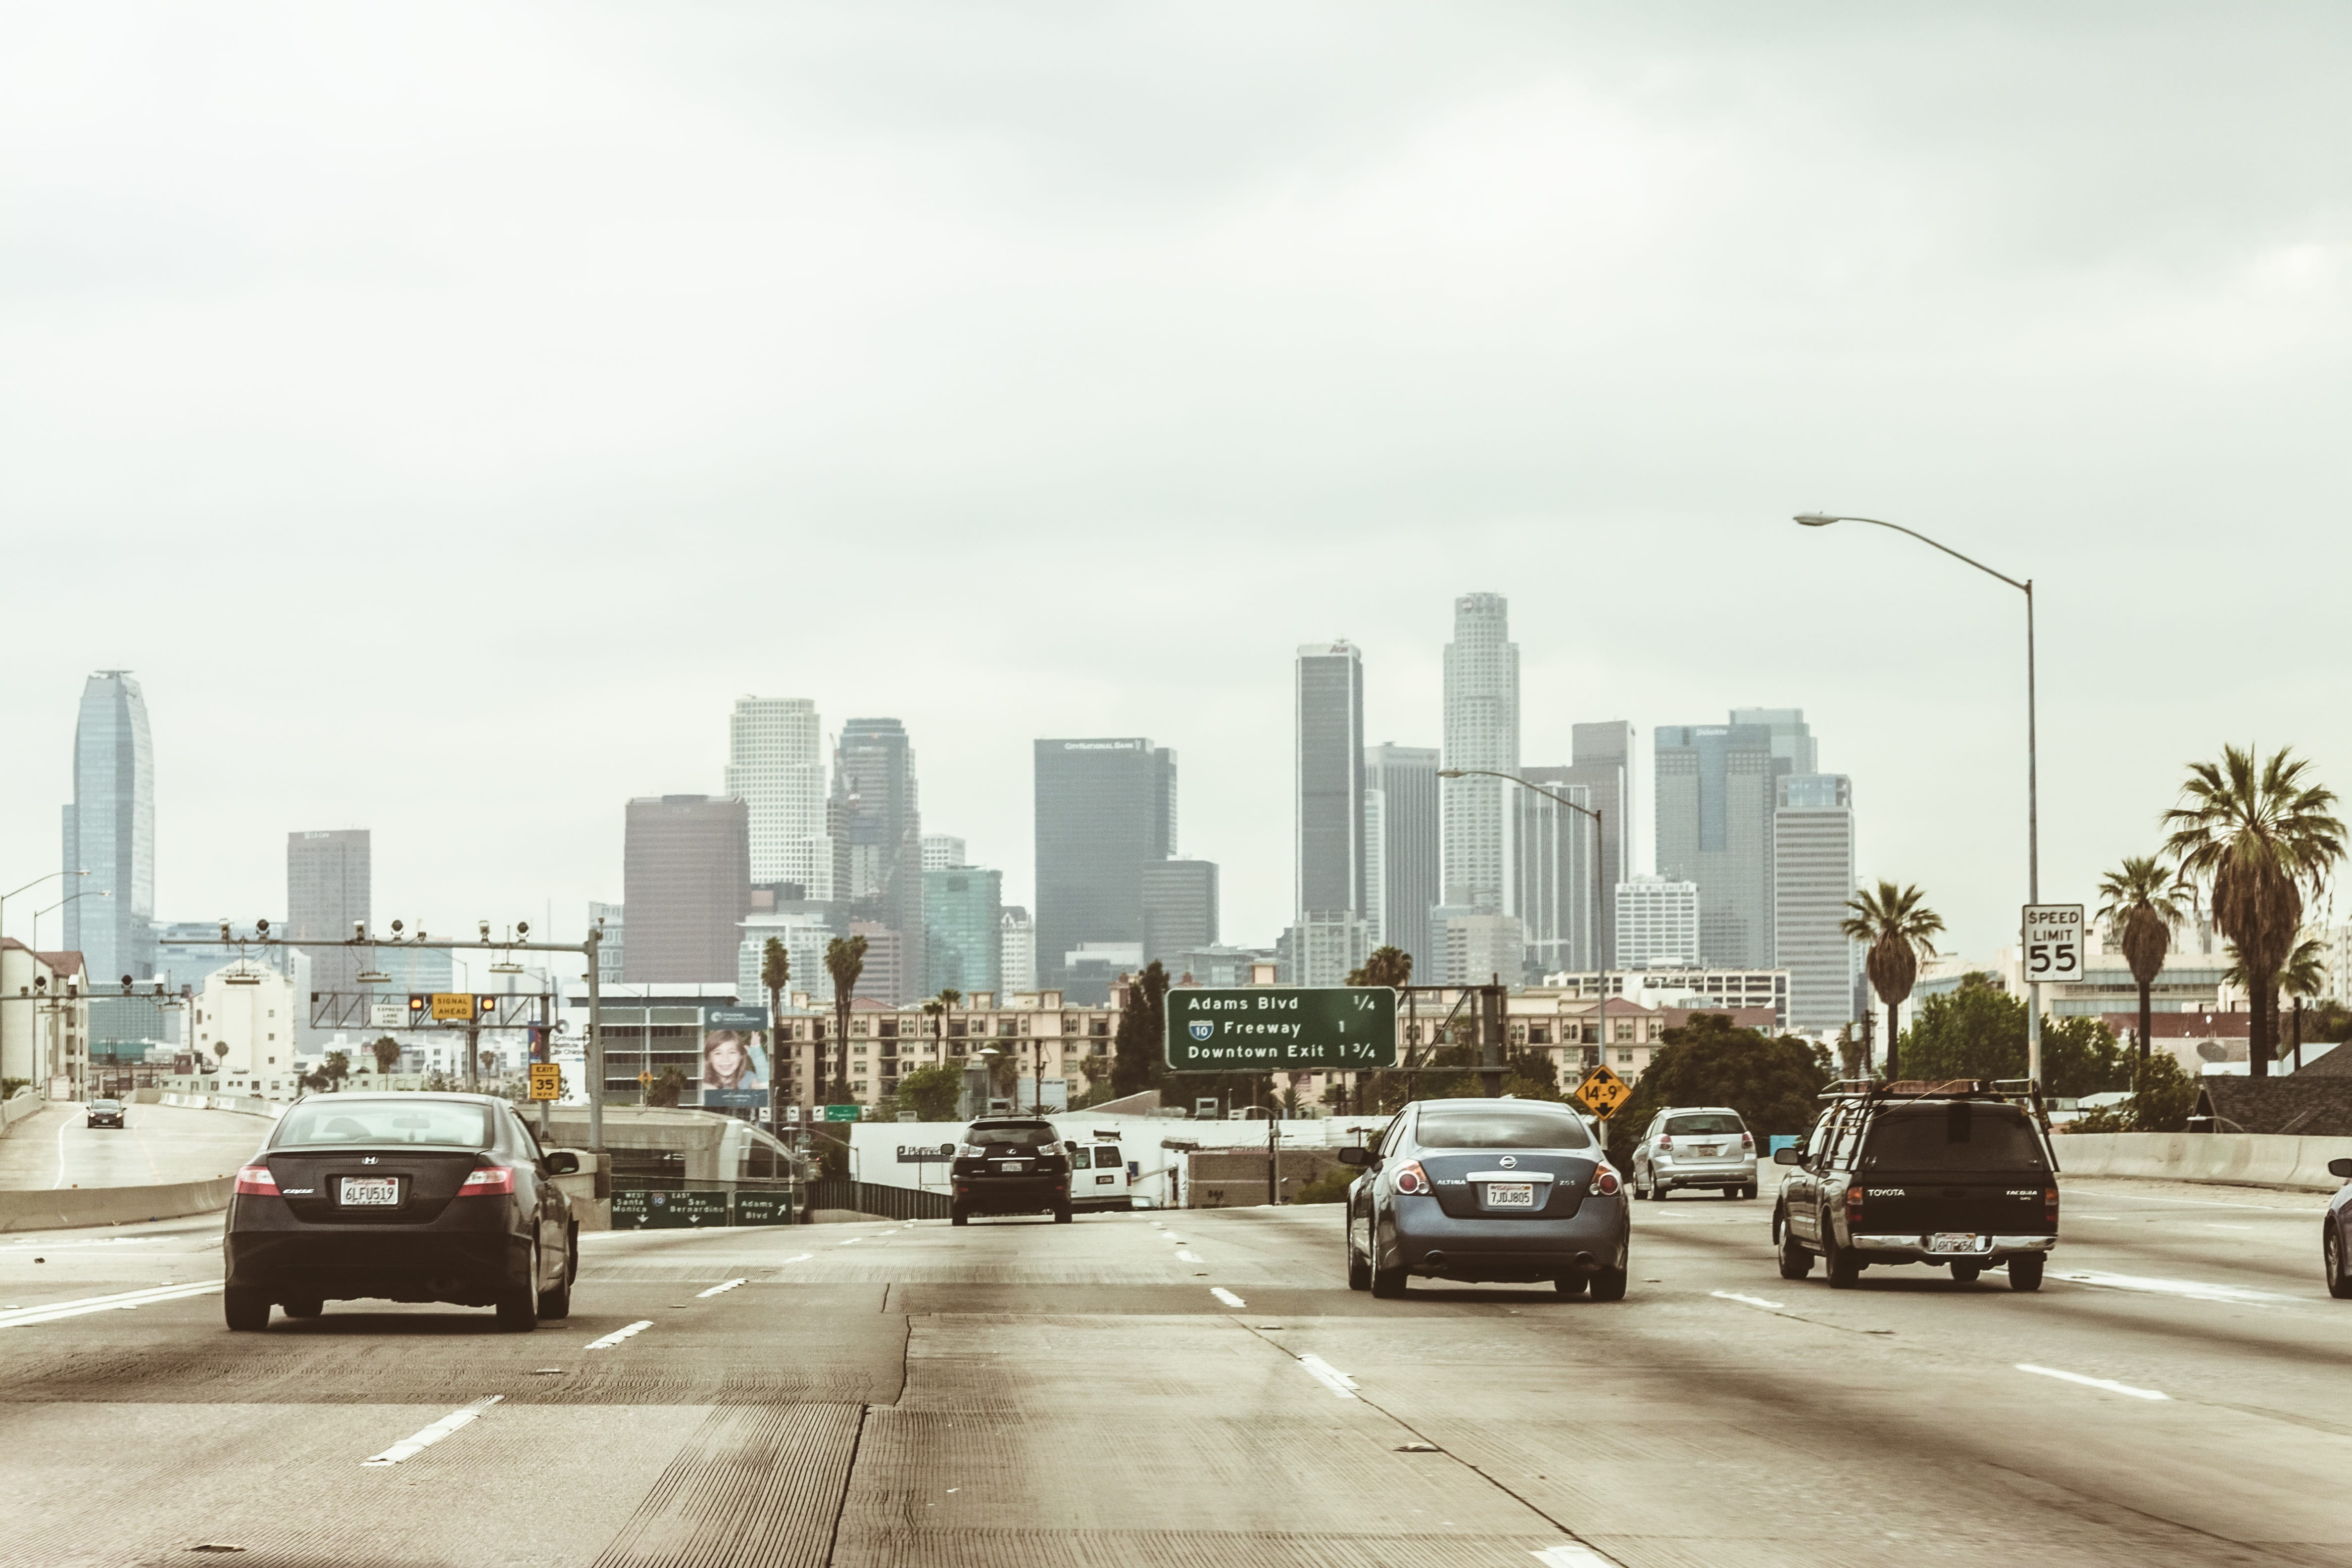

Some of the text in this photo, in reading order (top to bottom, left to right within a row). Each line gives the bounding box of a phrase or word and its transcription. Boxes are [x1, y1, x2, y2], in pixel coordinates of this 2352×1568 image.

[2028, 912, 2079, 924] SPEED
[2033, 930, 2073, 941] LIMIT
[2030, 944, 2076, 972] 55
[1188, 997, 1248, 1010] Adams
[1258, 997, 1298, 1009] Blvd
[1196, 1021, 1344, 1038] 10 Freeway 1
[1188, 1045, 1277, 1058] Downtown
[1288, 1044, 1324, 1057] Exit
[1339, 1045, 1345, 1057] 1
[536, 1079, 554, 1090] 35
[345, 1187, 394, 1200] 6LFU519
[1491, 1192, 1530, 1202] 7JDJ805
